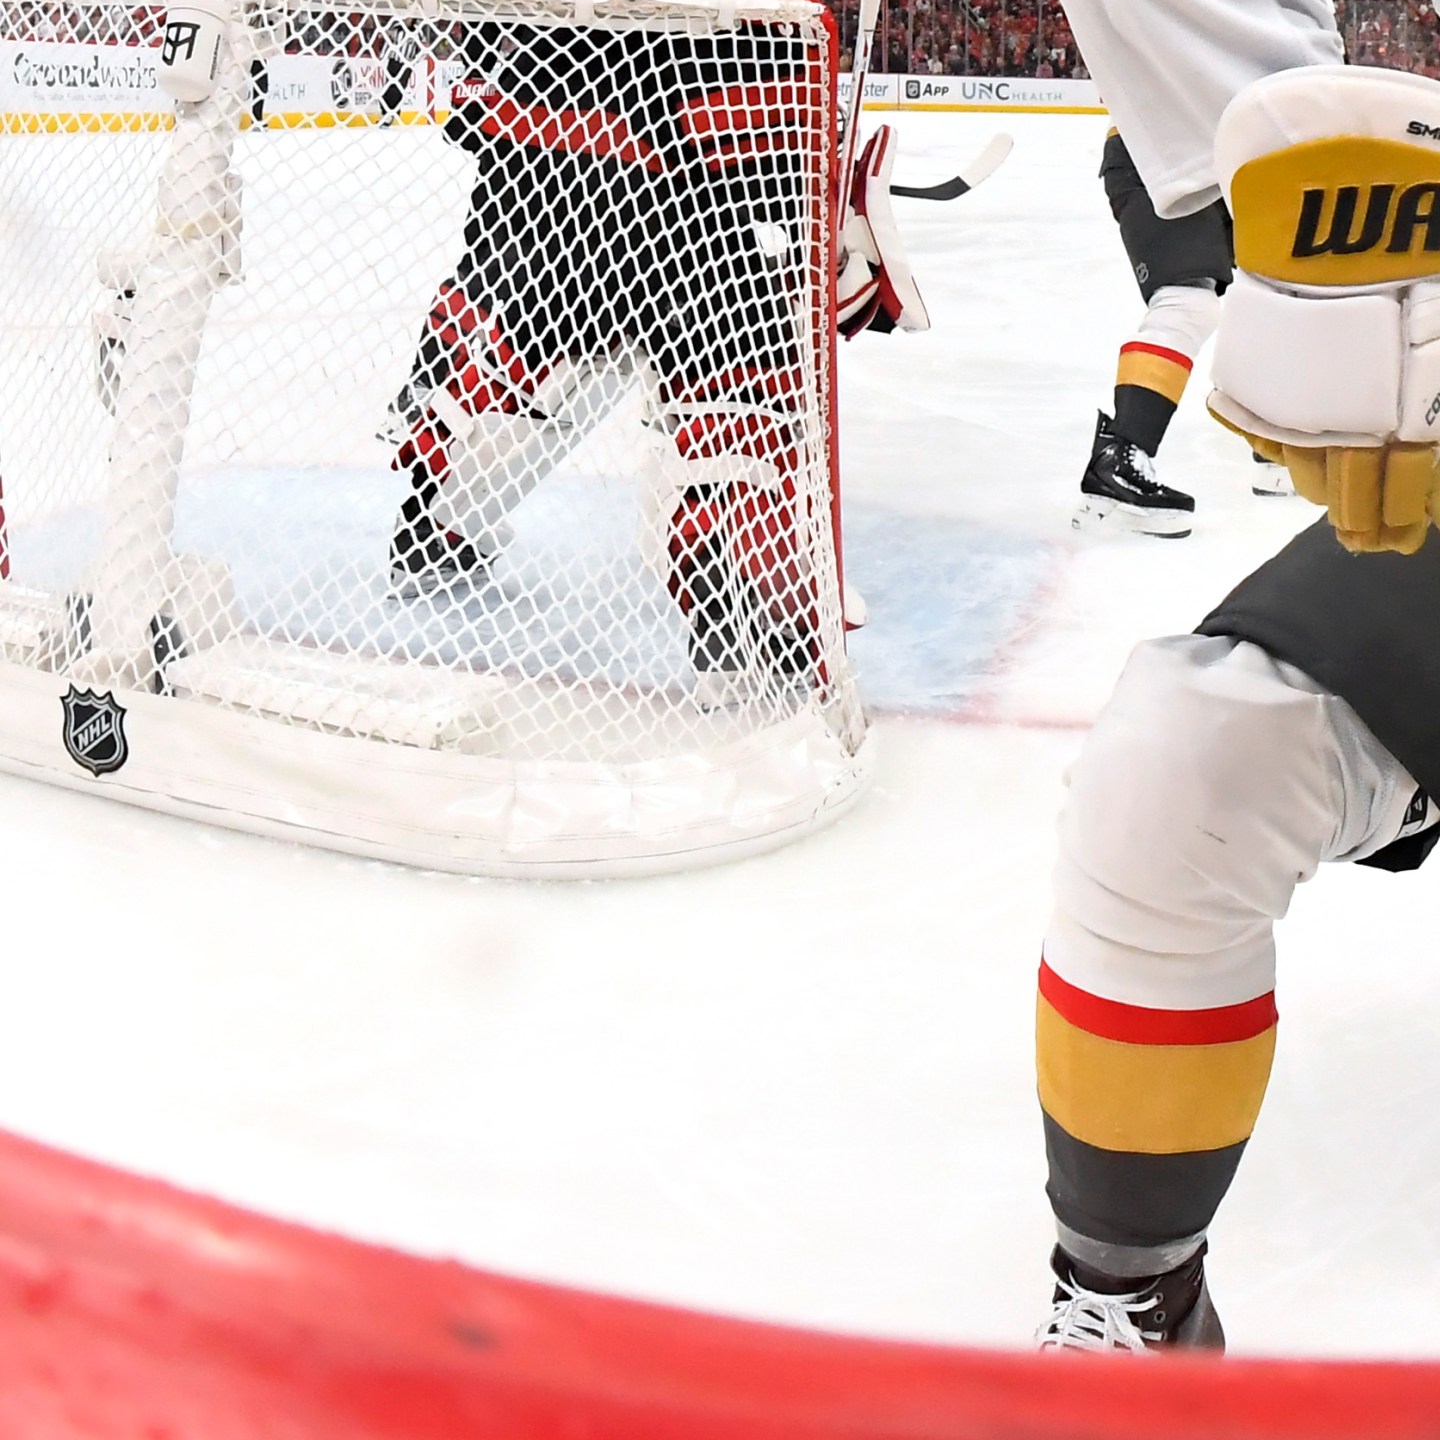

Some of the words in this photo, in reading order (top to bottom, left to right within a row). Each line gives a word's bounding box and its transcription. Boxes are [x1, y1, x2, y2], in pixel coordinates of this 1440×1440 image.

[961, 82, 1010, 100] UNC
[1013, 91, 1062, 101] HEALTH
[78, 713, 111, 752] NHL
